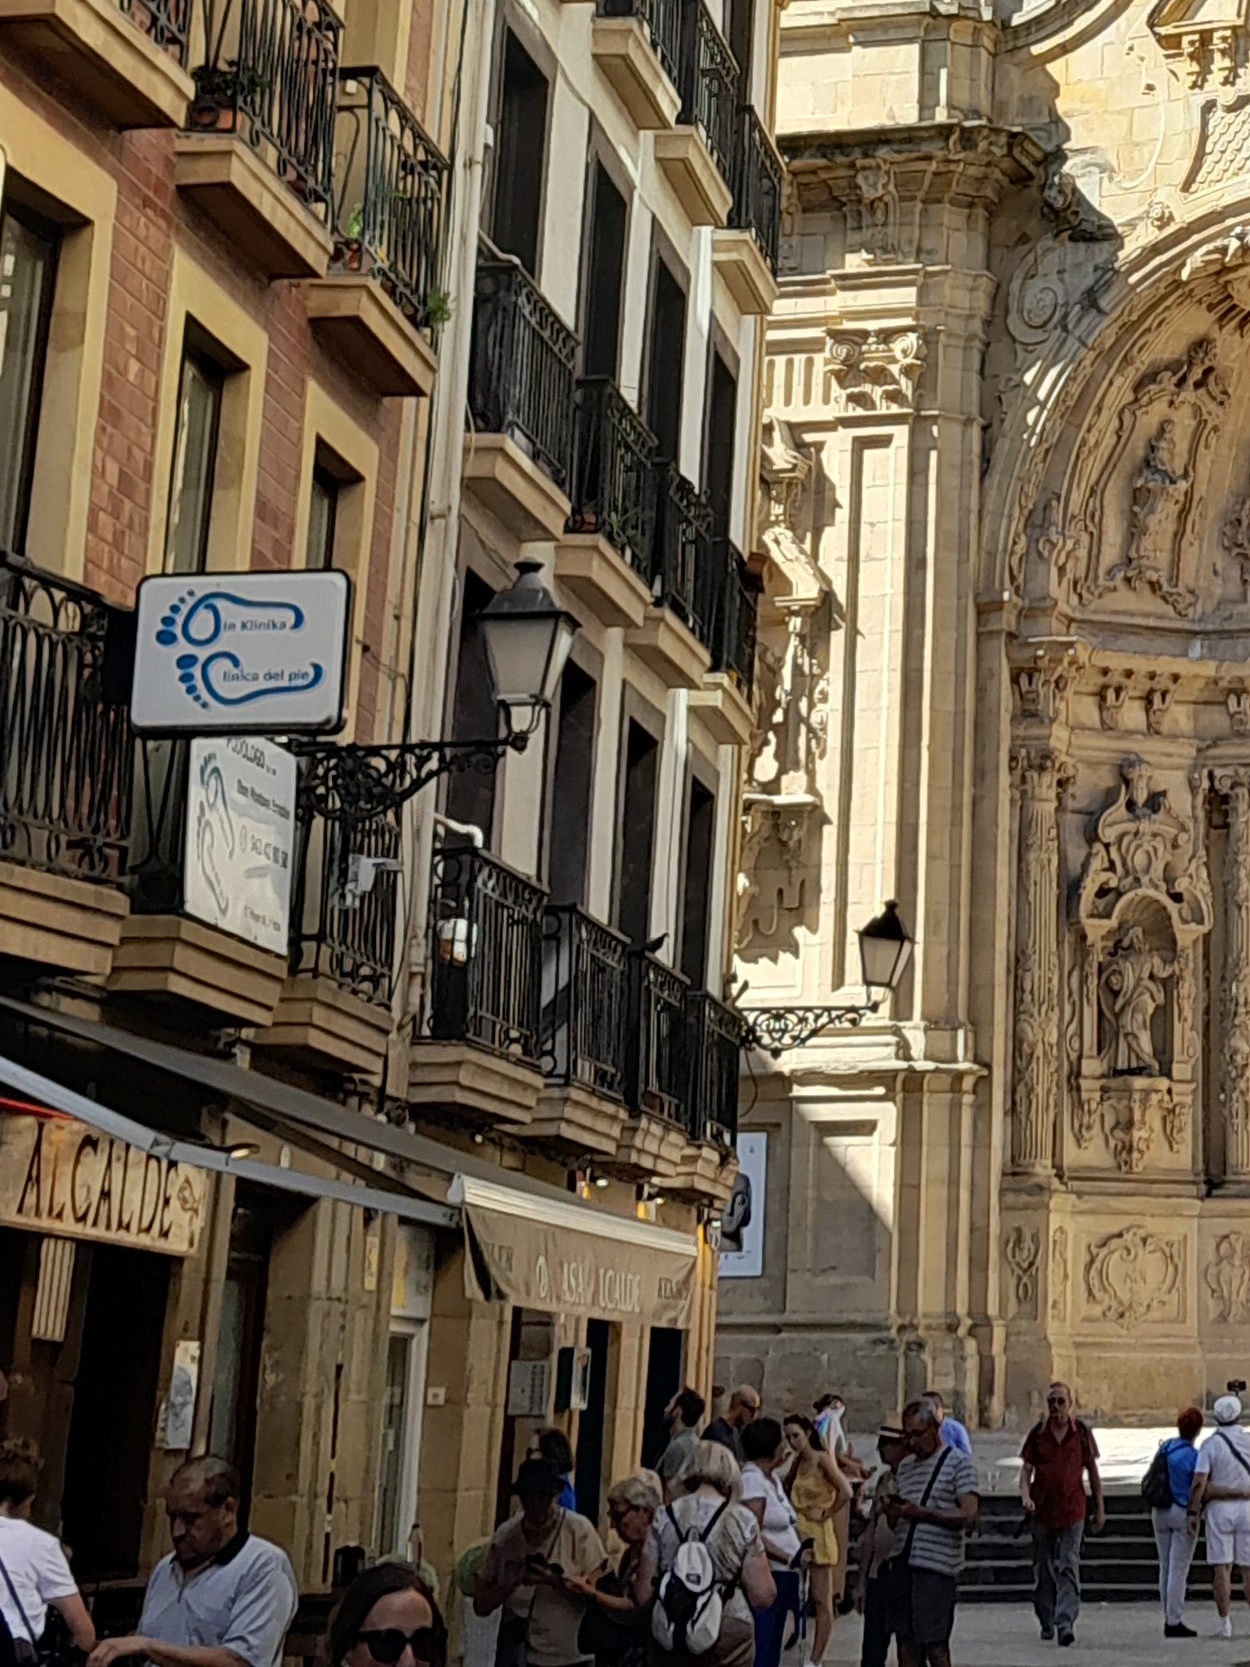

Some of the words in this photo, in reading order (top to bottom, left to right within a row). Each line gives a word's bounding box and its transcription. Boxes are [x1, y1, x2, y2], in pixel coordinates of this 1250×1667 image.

[240, 619, 288, 632] Klinika
[263, 669, 285, 682] del
[288, 670, 310, 685] pie
[16, 1121, 179, 1240] ALCALDE
